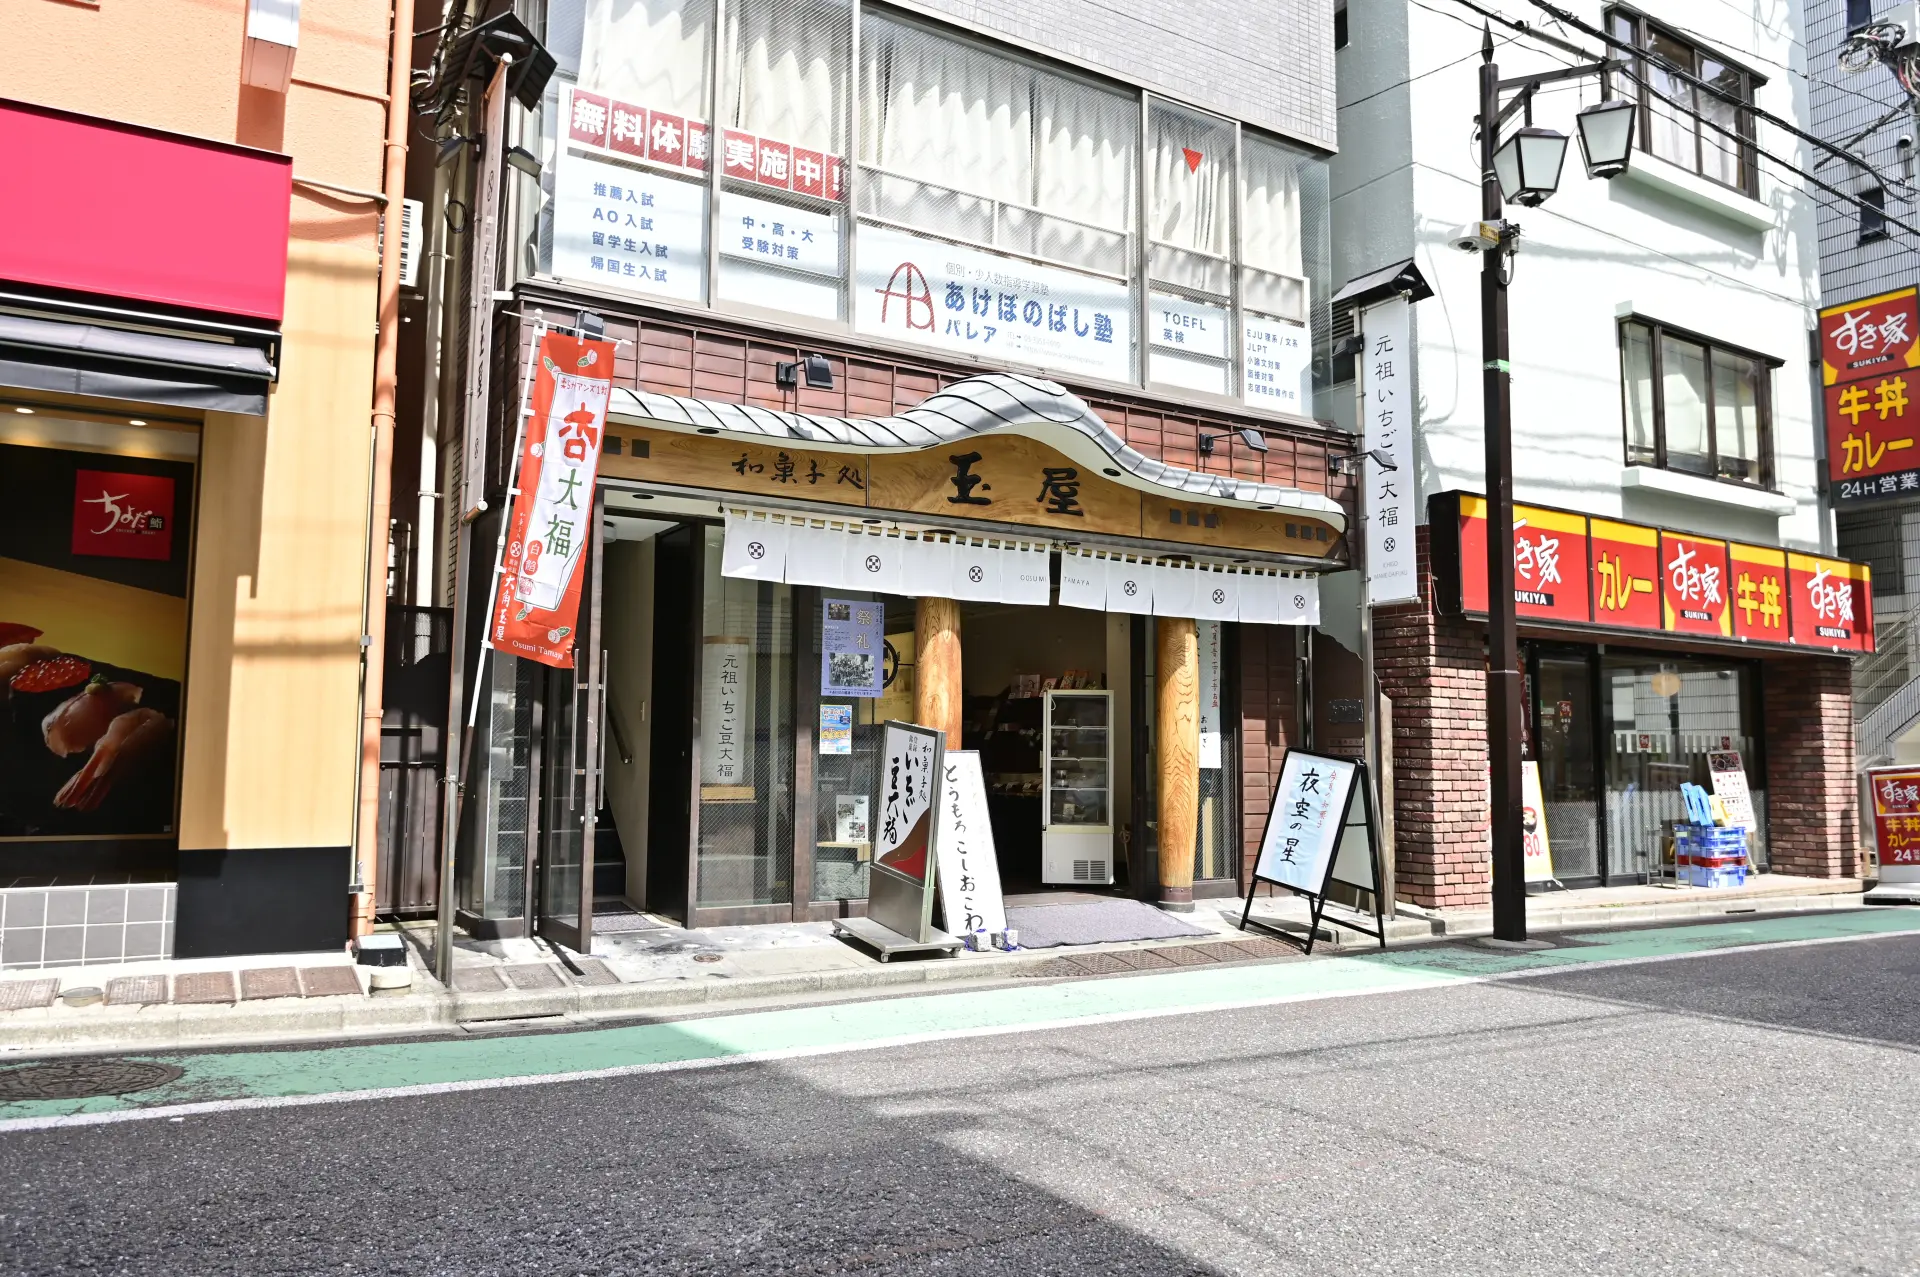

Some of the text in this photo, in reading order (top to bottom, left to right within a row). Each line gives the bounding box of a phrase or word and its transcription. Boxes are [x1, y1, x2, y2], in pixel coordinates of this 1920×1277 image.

[594, 181, 654, 208] 推薦入試
[592, 231, 668, 259] 留学生入試
[742, 236, 799, 261] 受験対策
[591, 256, 667, 283] 帰国生入試
[945, 281, 1113, 343] あけぼのばし塾
[1163, 311, 1206, 331] TOEFL
[945, 319, 997, 343] パレア
[1163, 328, 1185, 344] 英検
[1830, 310, 1910, 355] すき家
[1247, 342, 1268, 354] JLPT
[1853, 355, 1888, 369] SUKIYA
[1838, 376, 1909, 425] 牛丼
[1841, 431, 1914, 473] カレー
[948, 451, 1085, 517] 玉屋
[1063, 576, 1090, 586] TAMAYA
[1598, 551, 1652, 611] カレー
[1668, 543, 1722, 610] すき家
[1514, 591, 1547, 605] UKIYA
[1737, 571, 1781, 628] 牛丼
[1806, 562, 1855, 628] すき家
[856, 609, 872, 649] 祭礼
[1684, 611, 1709, 621] SUKIYA
[513, 640, 536, 652] Osumi
[1819, 626, 1848, 639] SUKIYA
[717, 654, 739, 777] 元祖いちご豆大福
[1881, 780, 1919, 803] すき家
[1280, 767, 1320, 866] 夜空の星
[1886, 817, 1920, 832] 牛丼
[943, 765, 983, 932] とうもろこしおこわ
[1894, 849, 1912, 862] 24
